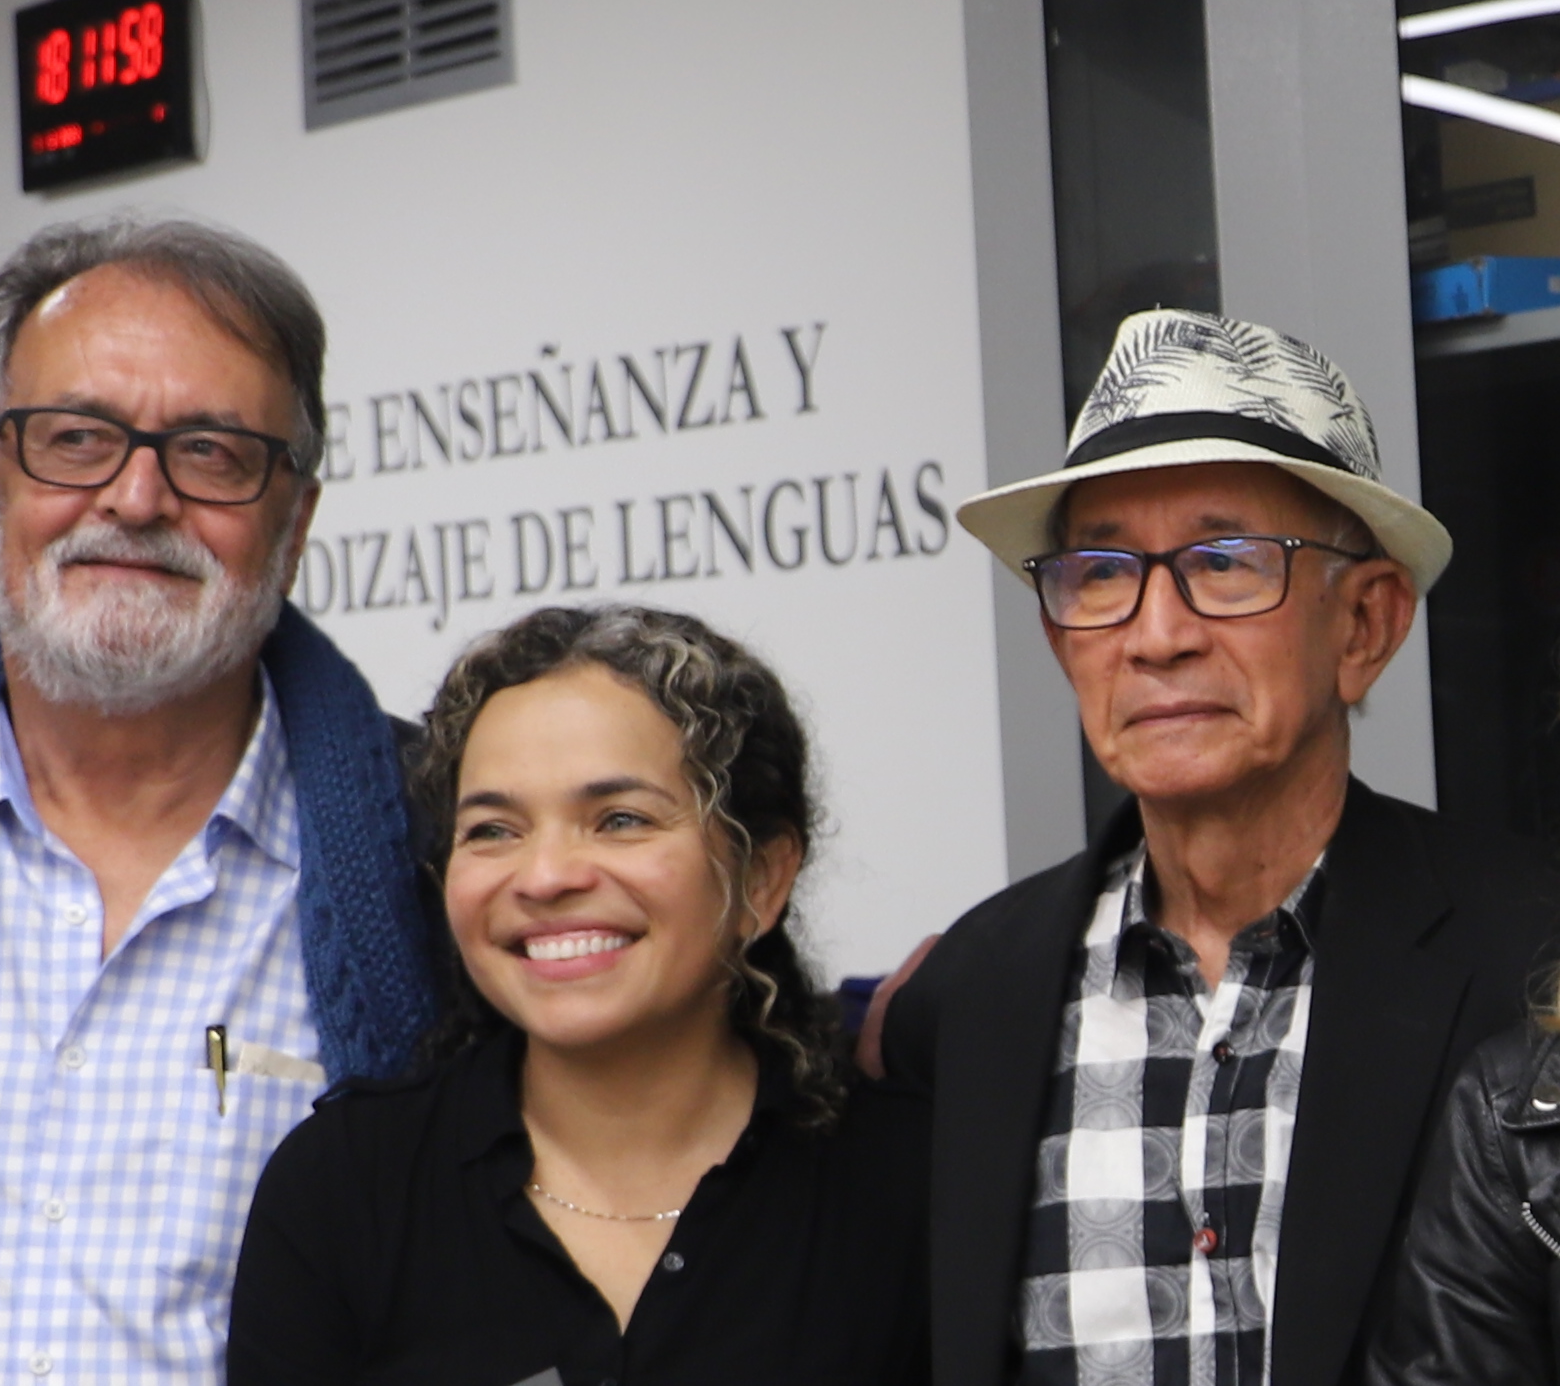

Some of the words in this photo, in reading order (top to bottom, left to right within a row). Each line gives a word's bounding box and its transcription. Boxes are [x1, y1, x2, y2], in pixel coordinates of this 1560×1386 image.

[322, 402, 356, 482] E
[369, 333, 765, 474] ENSEÑANZA
[780, 322, 828, 414] Y
[301, 519, 495, 632] DIZAJE
[511, 506, 597, 595] DE
[615, 460, 949, 585] LENGUAS
